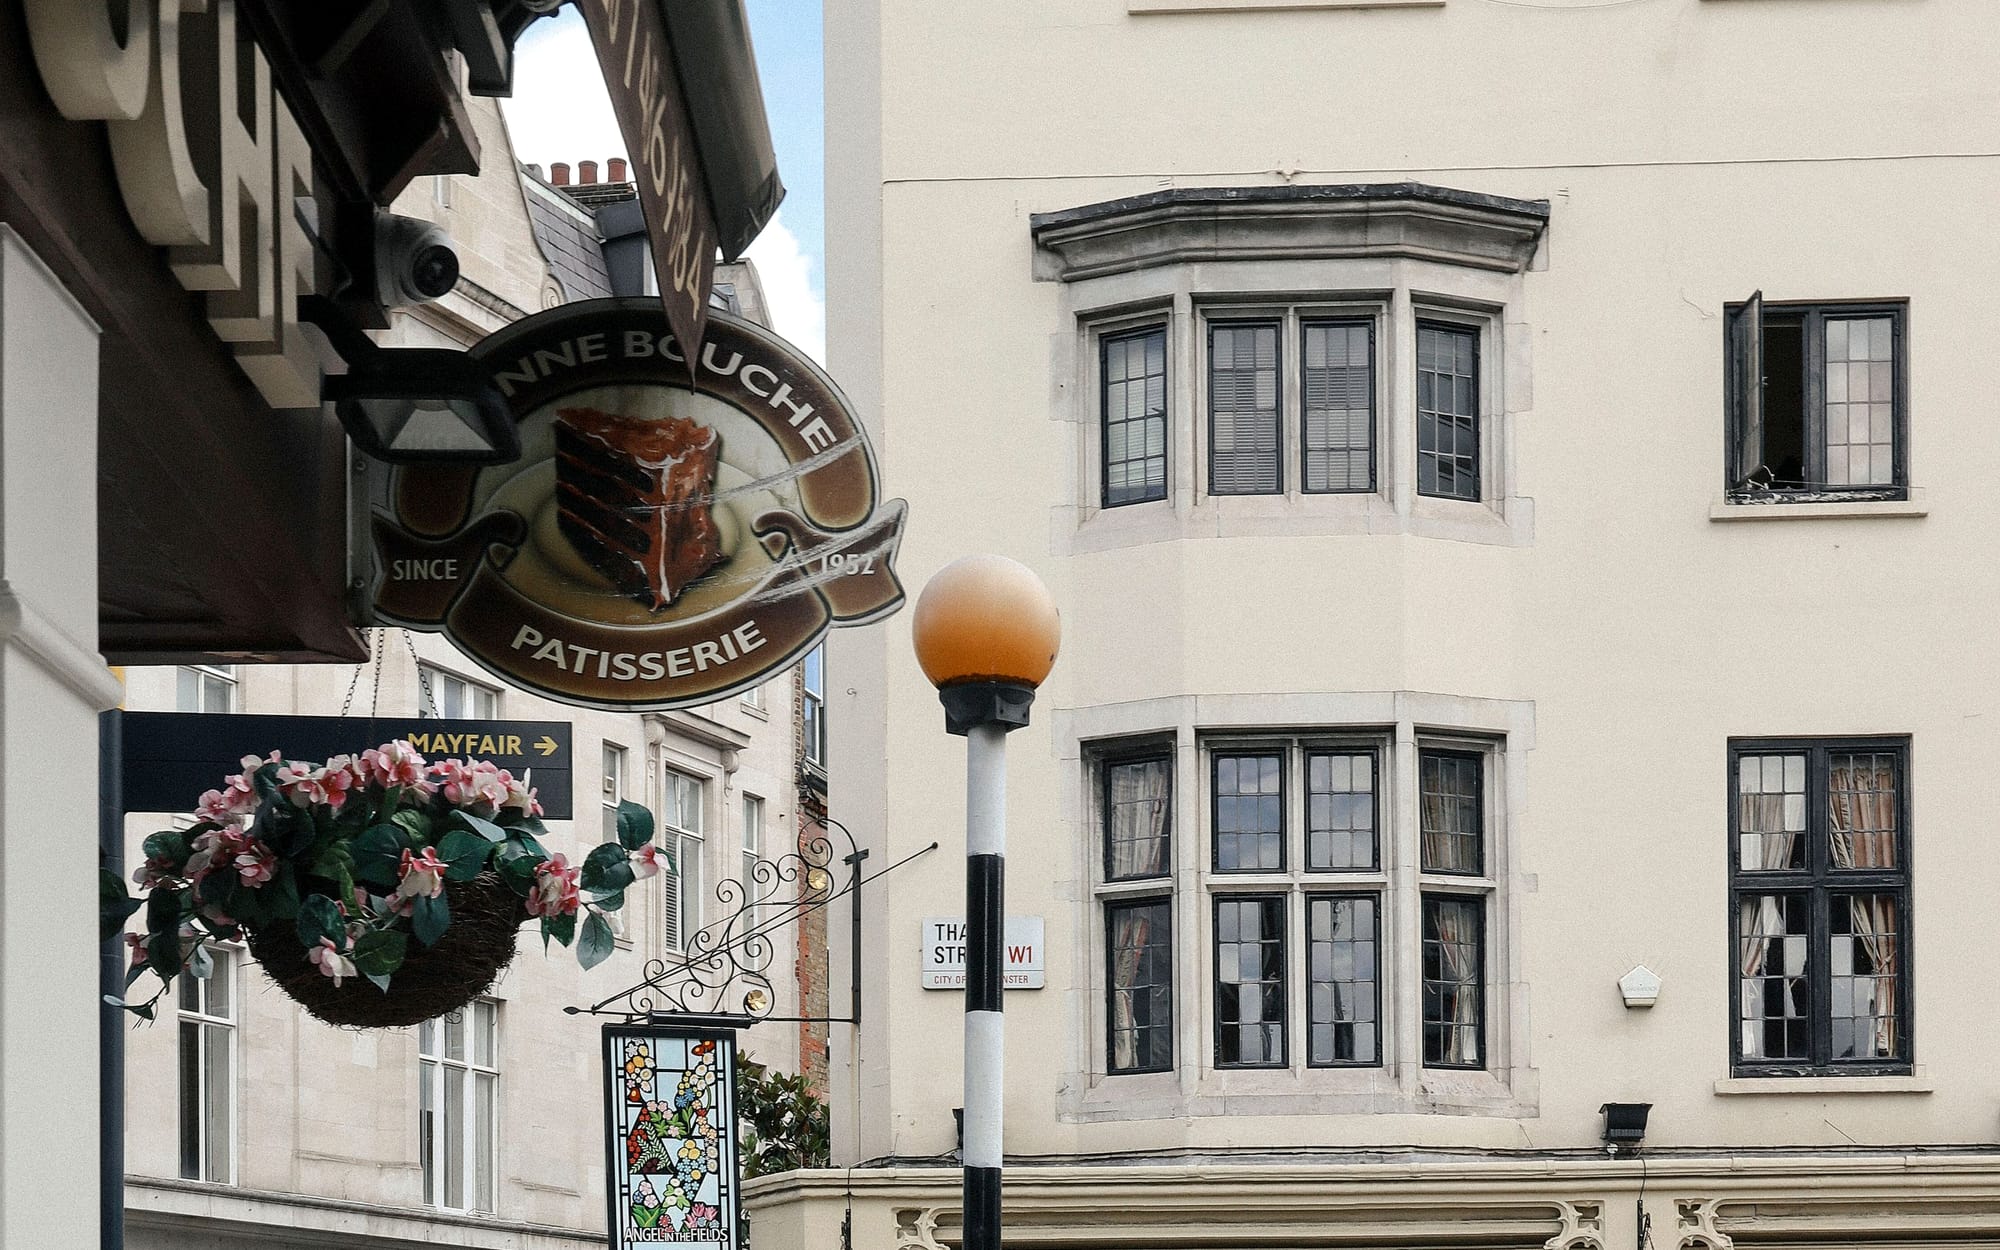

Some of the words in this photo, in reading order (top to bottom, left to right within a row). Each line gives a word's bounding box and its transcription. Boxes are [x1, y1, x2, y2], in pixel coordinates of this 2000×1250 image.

[494, 332, 608, 398] NNE
[392, 558, 458, 581] SINCE
[820, 553, 875, 576] 1952
[510, 619, 768, 681] PATISSERIE
[407, 732, 524, 756] MAYFAIR
[934, 923, 967, 942] THA
[934, 945, 967, 964] STR
[1007, 945, 1033, 964] W1
[934, 975, 953, 984] CITY
[624, 1227, 664, 1242] ANGEL
[690, 1227, 728, 1242] FIELDS
